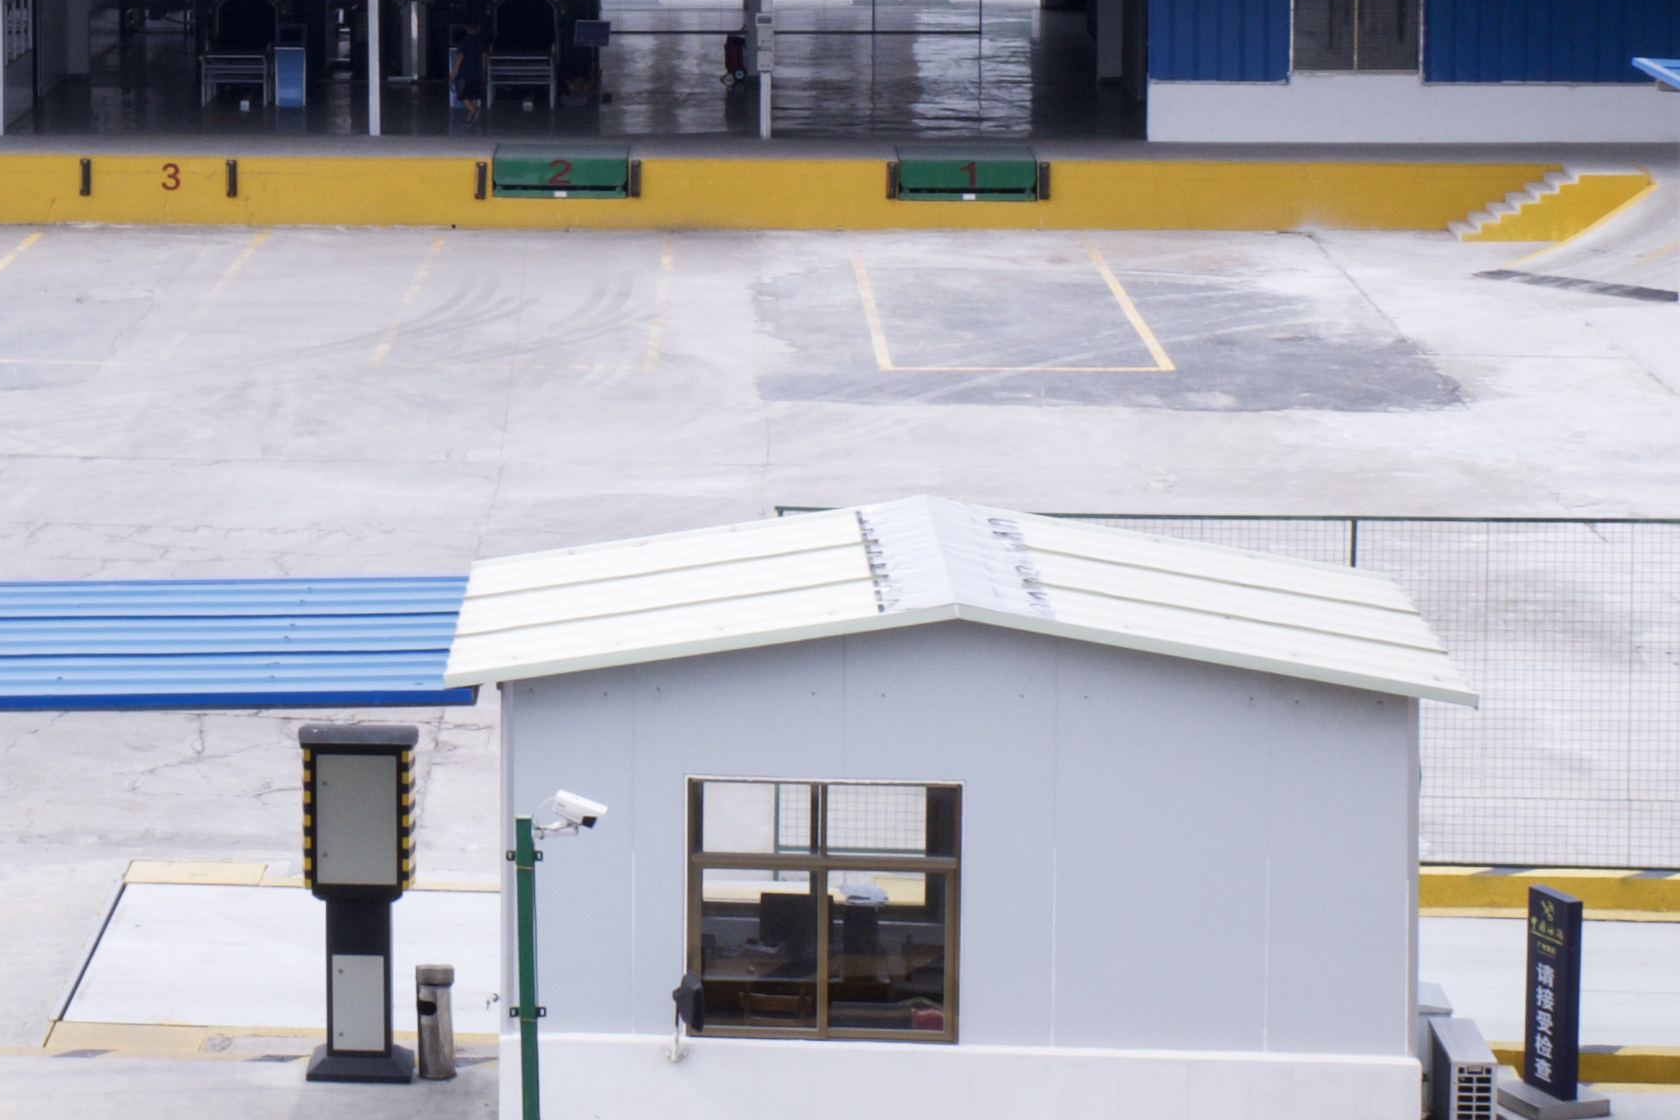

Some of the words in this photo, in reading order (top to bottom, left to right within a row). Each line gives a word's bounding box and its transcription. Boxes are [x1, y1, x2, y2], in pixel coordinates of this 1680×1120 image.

[161, 163, 180, 191] 3
[548, 160, 572, 185] 2
[960, 161, 976, 187] 1
